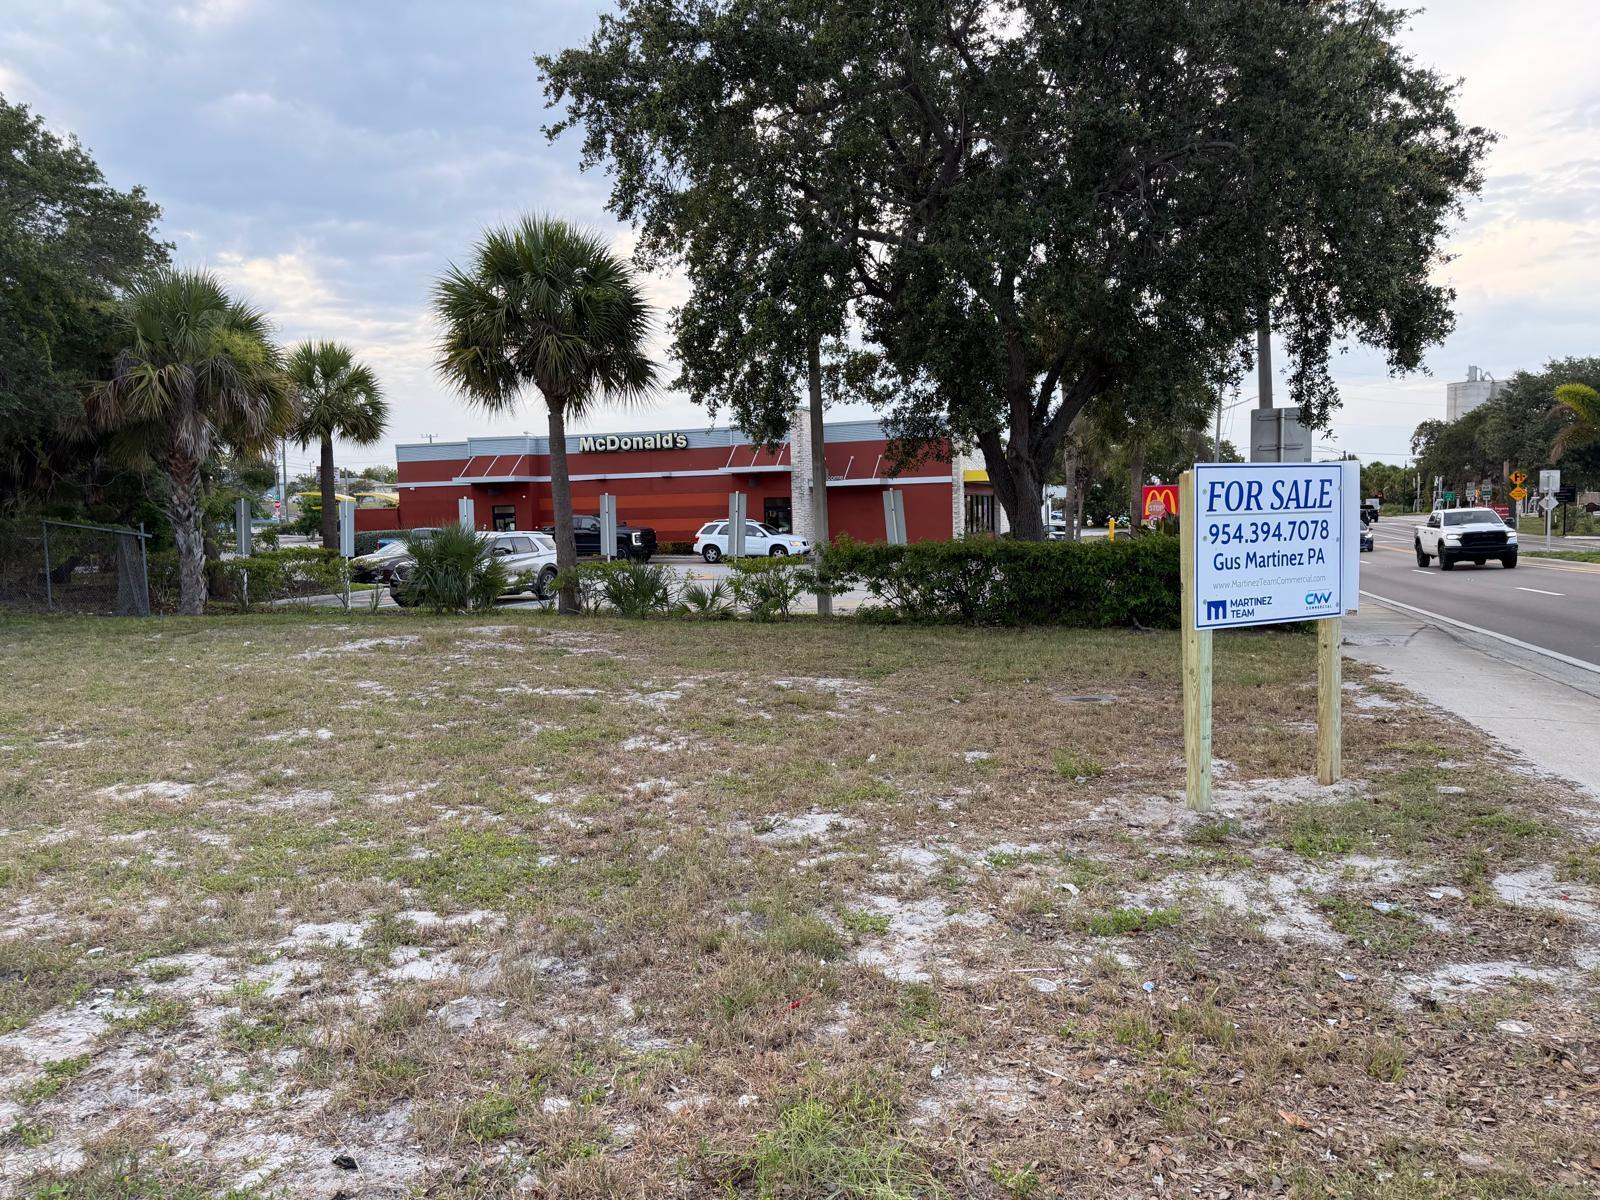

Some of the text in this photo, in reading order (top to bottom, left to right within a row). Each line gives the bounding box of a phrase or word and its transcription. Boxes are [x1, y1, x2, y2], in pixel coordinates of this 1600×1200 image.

[579, 432, 688, 452] McDonald's
[1206, 478, 1333, 512] FOR SALE
[1208, 519, 1330, 545] 954.394.7078
[1213, 547, 1326, 571] Gus Martinez PA
[1212, 574, 1327, 590] www.MartinezTeamCommercial.com
[1230, 596, 1273, 608] MARTINEZ
[1230, 609, 1255, 619] TEAM
